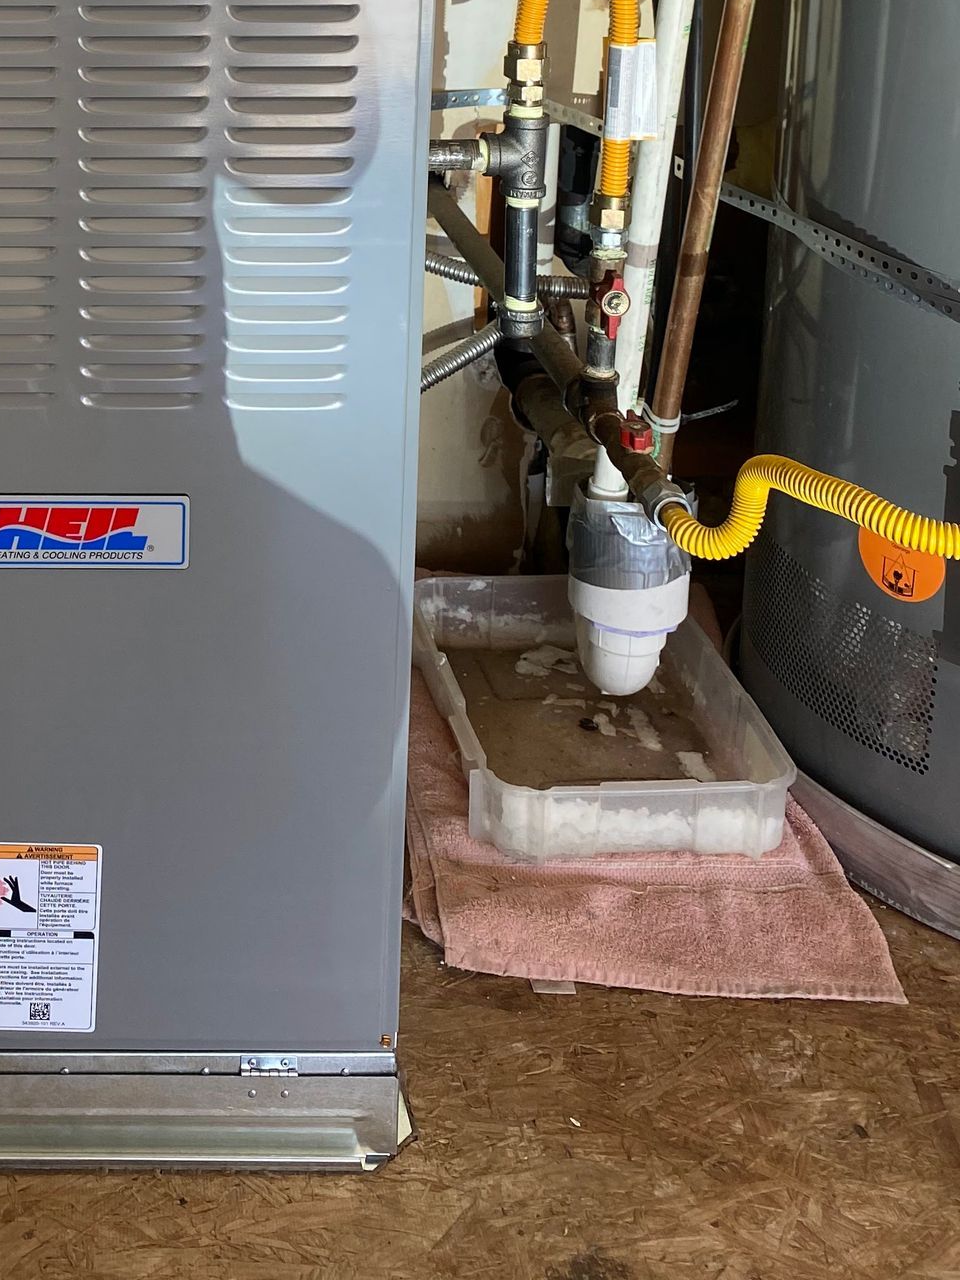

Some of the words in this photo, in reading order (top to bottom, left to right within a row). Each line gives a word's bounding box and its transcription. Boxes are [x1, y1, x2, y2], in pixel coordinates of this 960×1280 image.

[33, 552, 40, 560] &
[42, 552, 86, 560] COOLING
[88, 552, 143, 560] PRODUCTS
